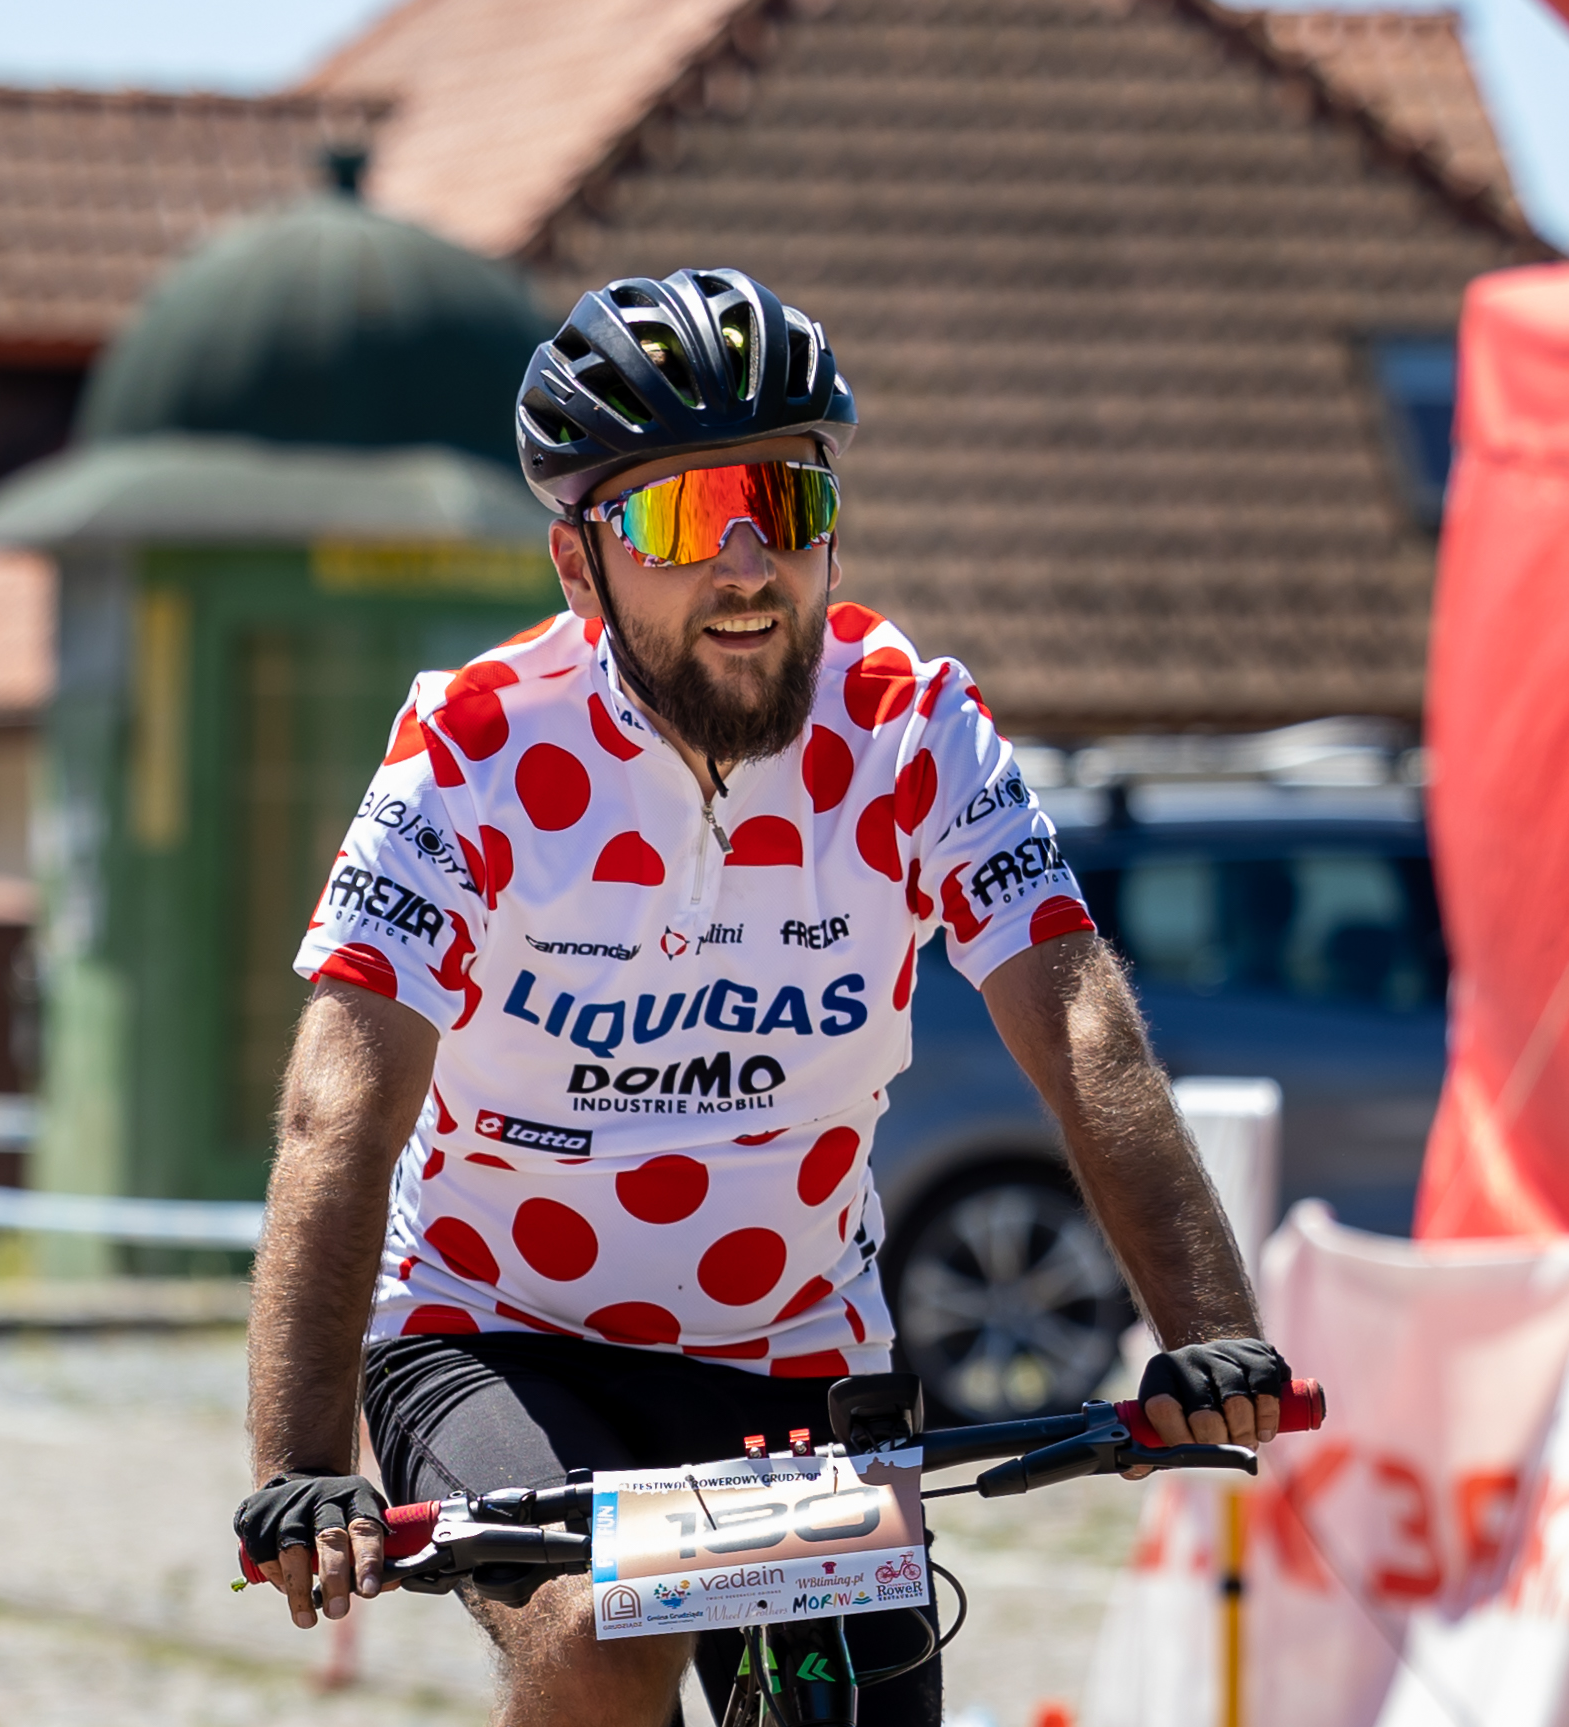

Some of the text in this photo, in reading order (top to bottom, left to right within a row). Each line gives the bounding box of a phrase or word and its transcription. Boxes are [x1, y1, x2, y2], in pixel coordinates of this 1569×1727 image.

[335, 910, 410, 945] OFFICE
[503, 968, 868, 1058] LIQUIGAS
[566, 1052, 786, 1098] DOIMO
[573, 1095, 774, 1114] INDUSTRIE MOBILI
[506, 1124, 586, 1150] lotto
[691, 1474, 759, 1489] ROWEROWY
[699, 1565, 785, 1591] vadain
[793, 1590, 852, 1614] MORIW
